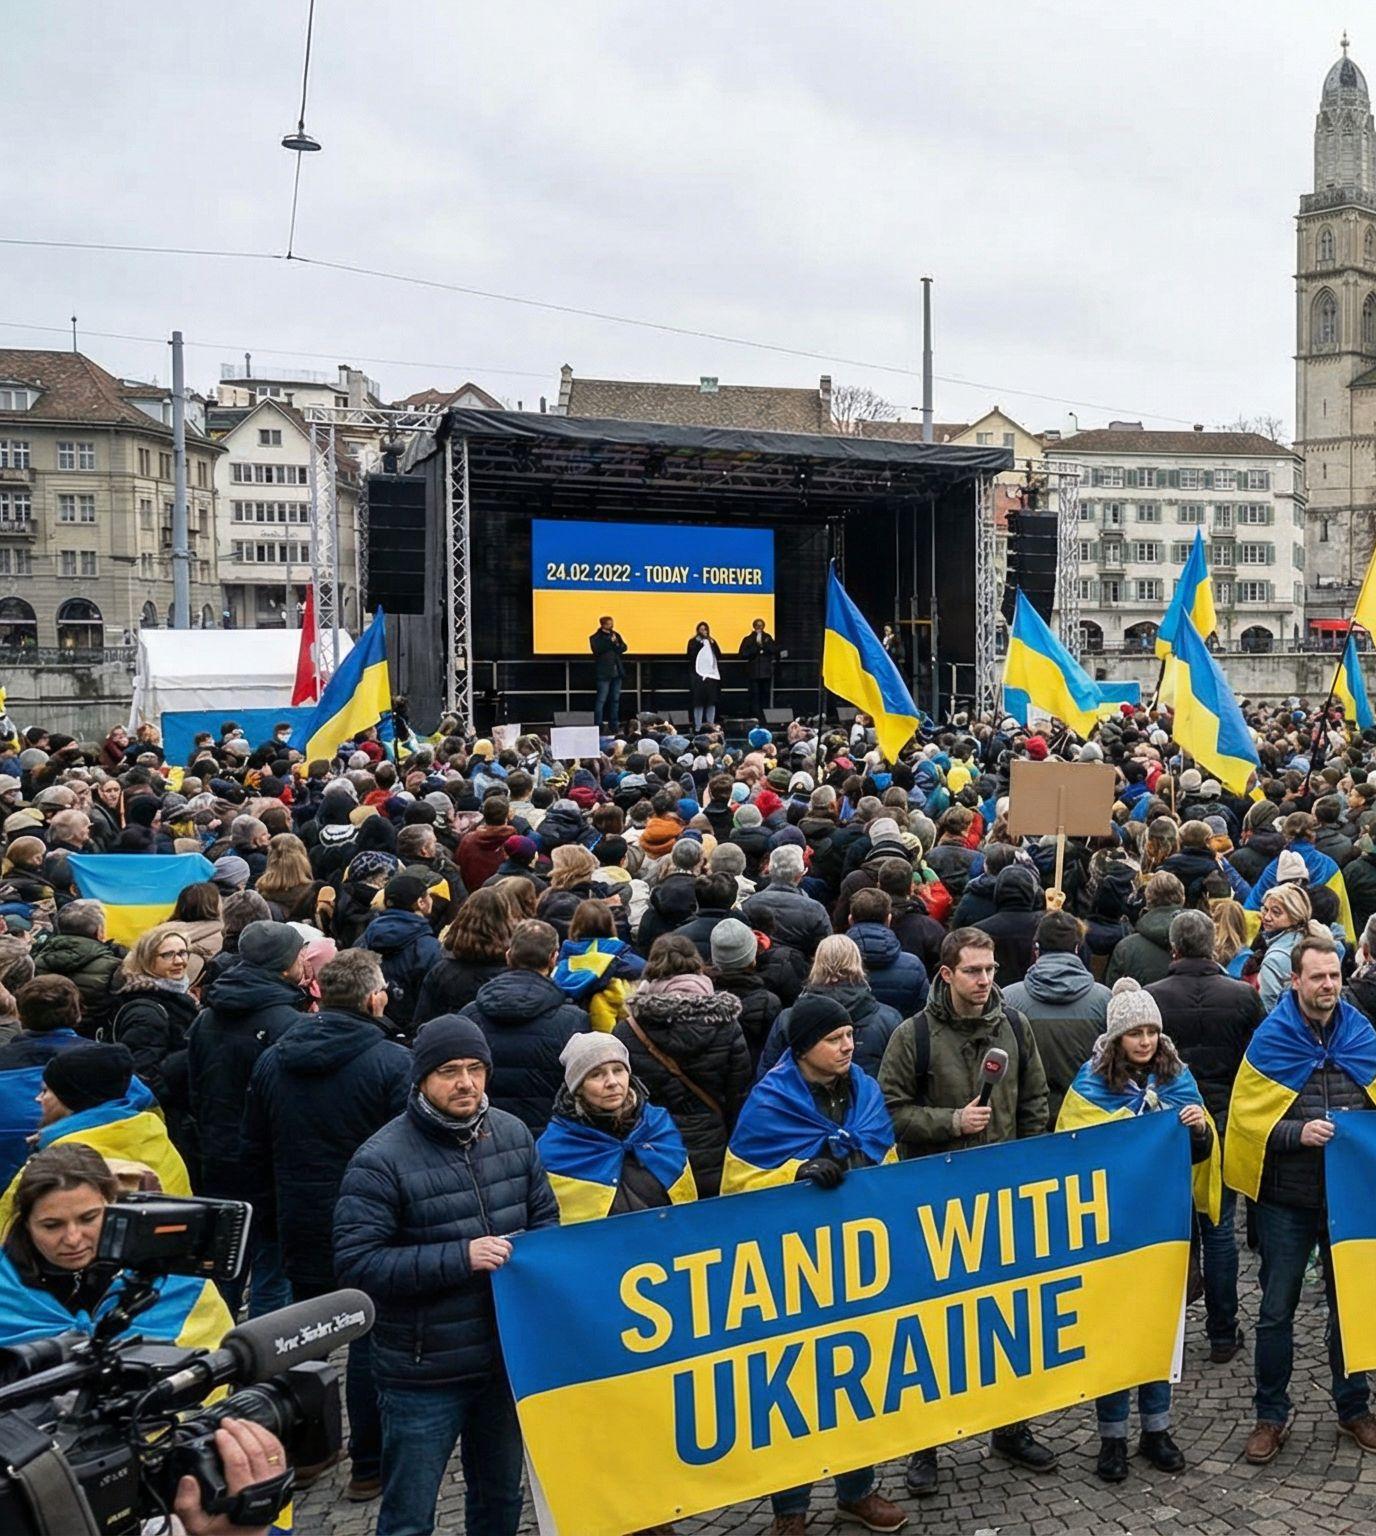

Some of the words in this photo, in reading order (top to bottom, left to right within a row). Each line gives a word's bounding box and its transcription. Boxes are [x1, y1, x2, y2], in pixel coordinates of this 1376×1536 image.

[546, 562, 631, 582] 24.02.2022
[644, 565, 690, 584] TODAY
[702, 567, 762, 585] FOREVER
[620, 1216, 891, 1354] STAND
[917, 1168, 1110, 1281] WITH
[672, 1275, 1086, 1466] UKRAINE
